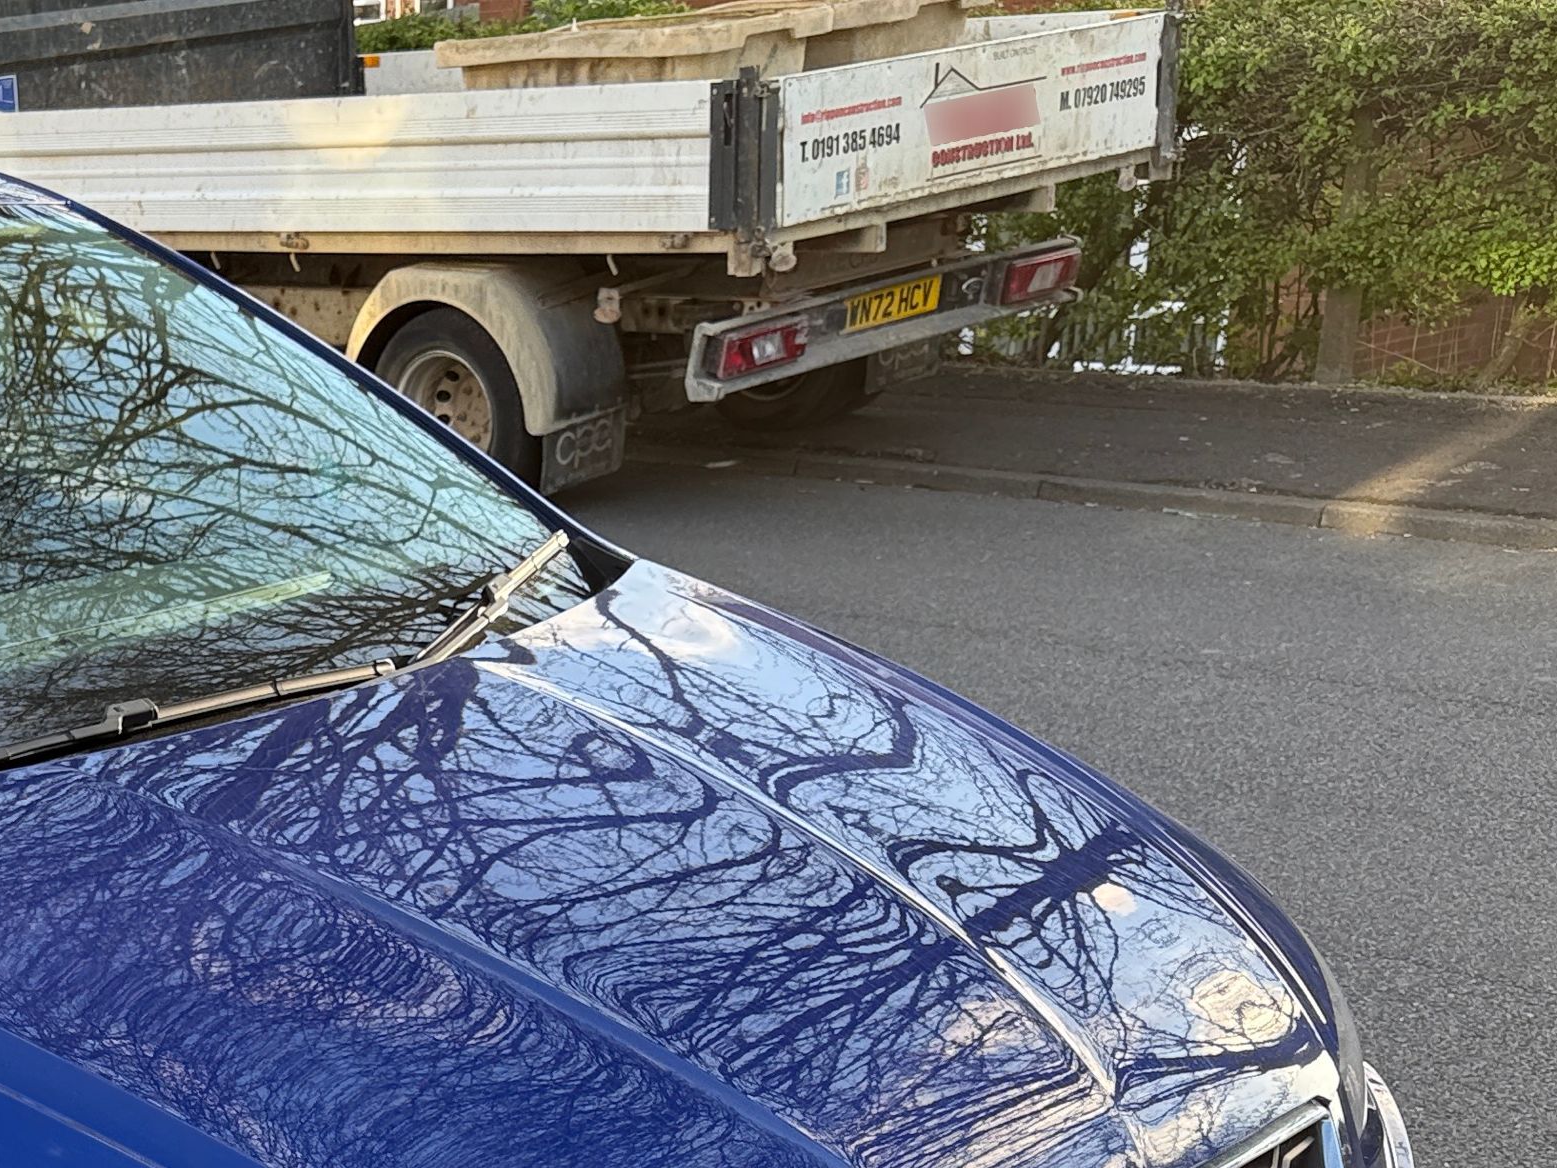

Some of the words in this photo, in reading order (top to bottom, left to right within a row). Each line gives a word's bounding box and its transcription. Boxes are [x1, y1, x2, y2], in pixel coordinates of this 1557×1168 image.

[1059, 90, 1072, 112] M.
[1074, 83, 1107, 109] 07920
[1108, 75, 1146, 102] 749295
[800, 141, 809, 163] T.
[811, 134, 840, 161] 0191
[842, 129, 866, 154] 385
[869, 122, 901, 148] 4694
[931, 135, 1015, 168] CONSTRUCTION
[897, 279, 934, 315] HCV
